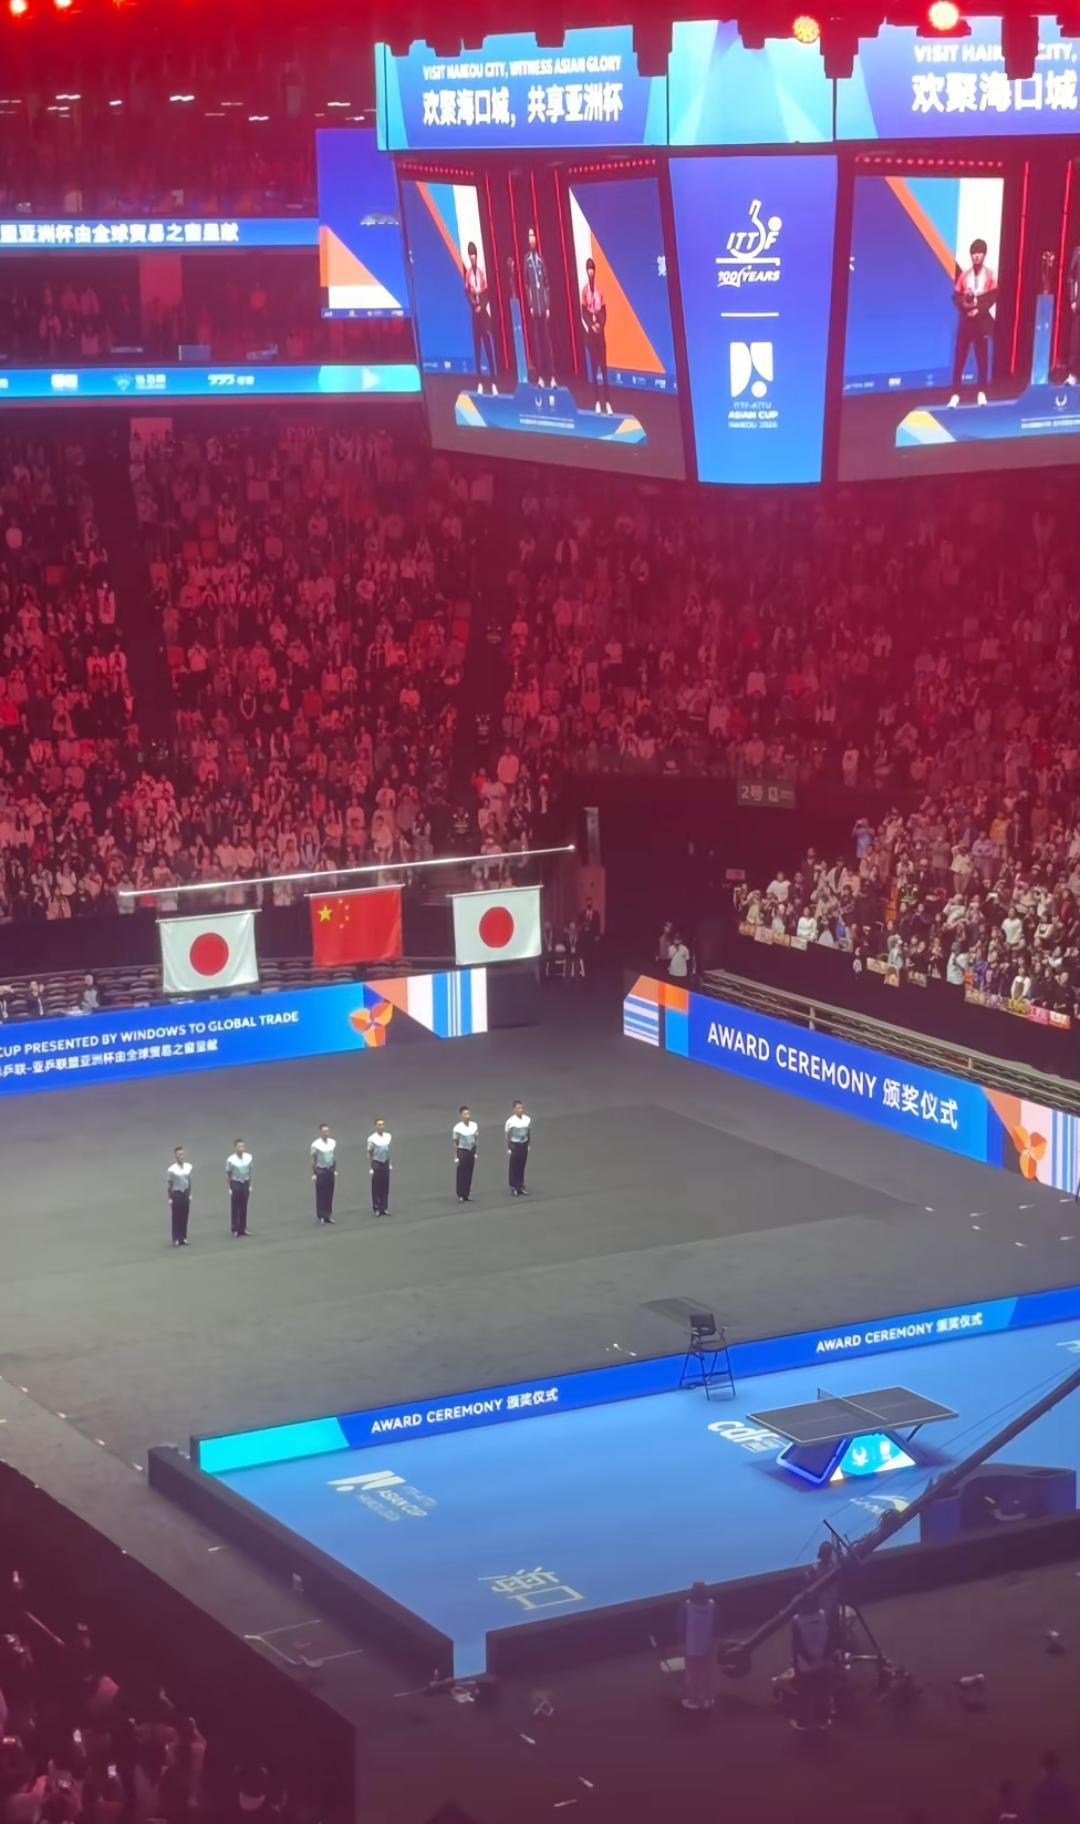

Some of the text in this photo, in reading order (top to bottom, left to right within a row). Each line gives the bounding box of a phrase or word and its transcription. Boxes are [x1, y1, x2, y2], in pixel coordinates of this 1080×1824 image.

[914, 44, 958, 63] VISIT
[961, 43, 1005, 62] HAIK
[911, 68, 1078, 114] 欢聚海口城
[726, 231, 779, 250] ITTF
[728, 410, 779, 420] ASIAN CUP
[24, 1035, 99, 1055] PRESENTED
[102, 1033, 118, 1045] BY
[120, 1024, 187, 1043] WINDOWS
[189, 1022, 206, 1034] TO
[208, 1016, 257, 1032] GLOBAL
[259, 1011, 299, 1026] TRADE
[707, 1022, 958, 1129] AWARD CEREMONY 颁奖仪式
[816, 1334, 861, 1353] AWARD
[864, 1322, 934, 1344] CEREMONY
[371, 1413, 422, 1433] AWARD
[426, 1399, 503, 1423] CEREMONY
